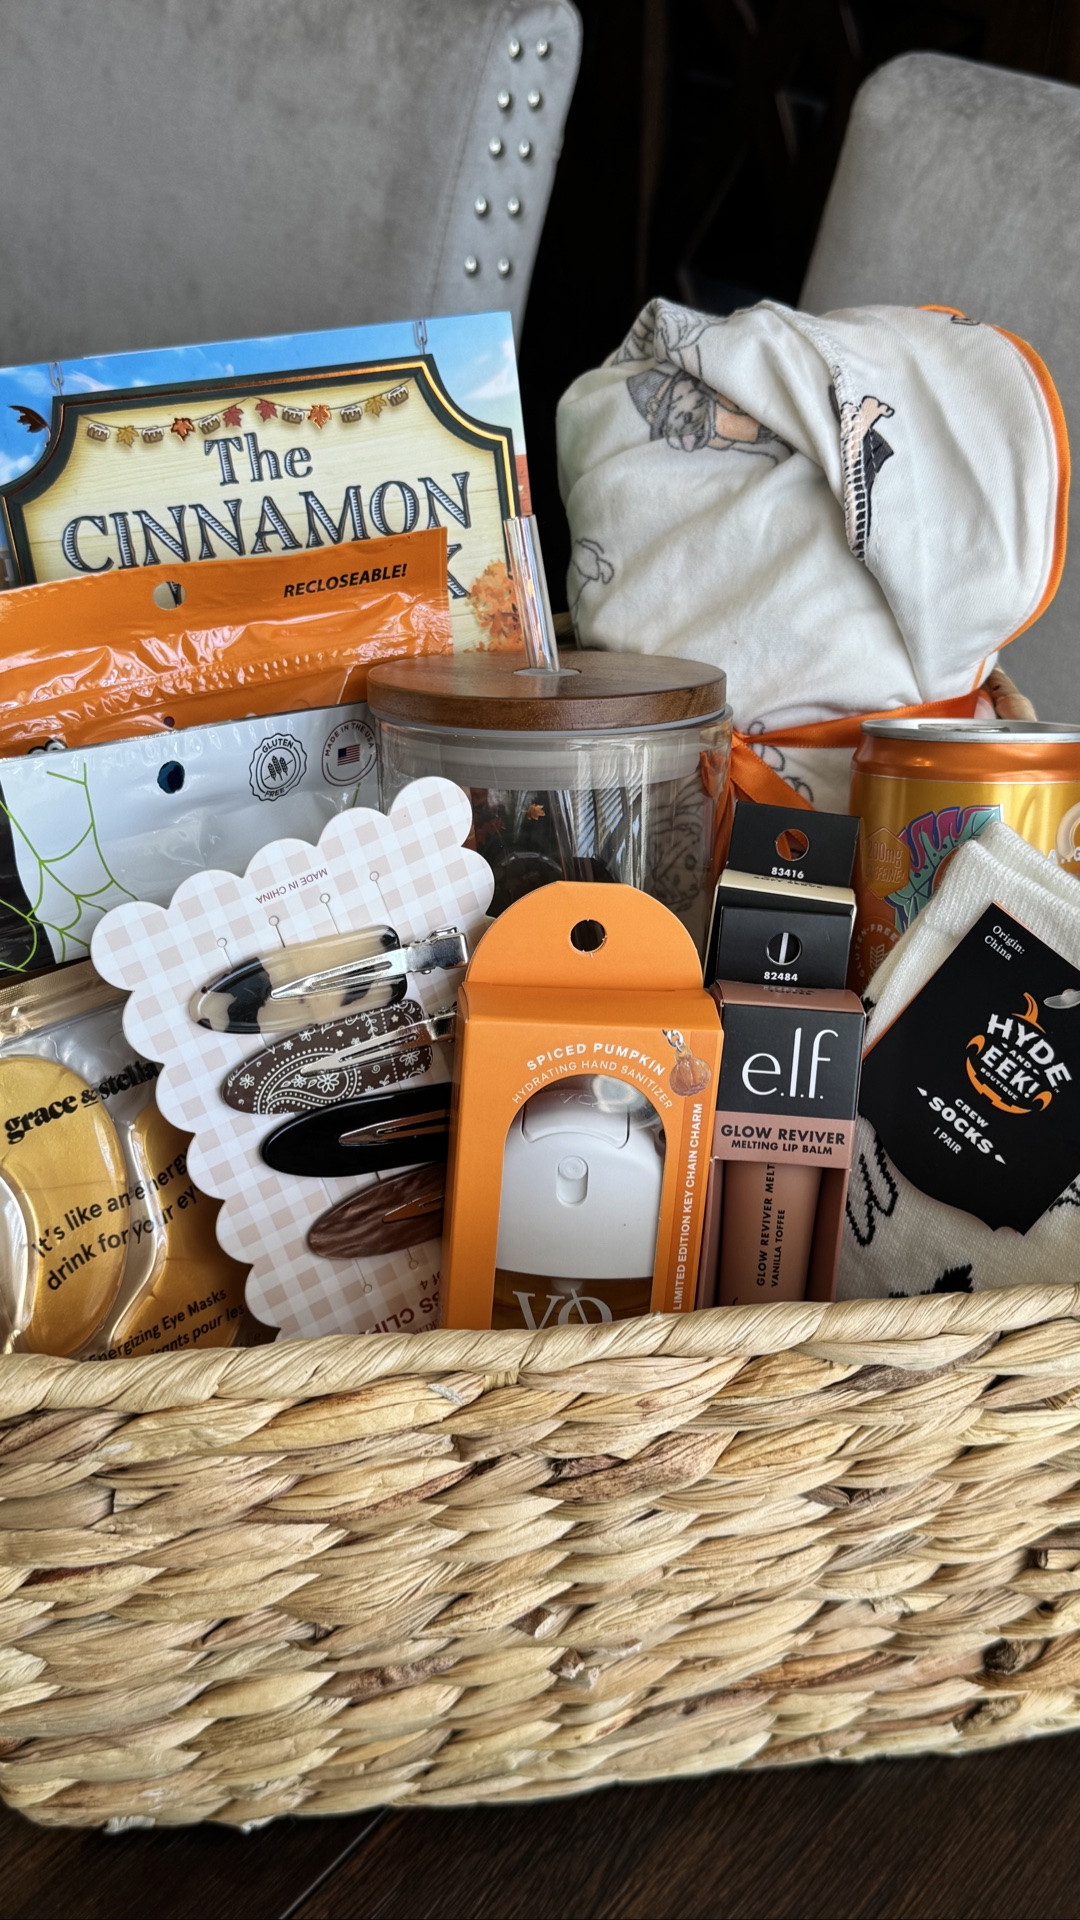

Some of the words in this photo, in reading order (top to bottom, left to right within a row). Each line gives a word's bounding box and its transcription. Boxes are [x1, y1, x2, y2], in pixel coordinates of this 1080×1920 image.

[204, 432, 313, 486] The
[62, 471, 471, 573] CINNAMON
[284, 563, 407, 598] RECLOSEABLE!
[262, 738, 295, 754] GLUTEN
[325, 731, 340, 757] MADE
[341, 723, 349, 733] IN
[351, 722, 365, 734] THE
[364, 728, 375, 749] USA
[264, 787, 285, 798] FREE
[288, 880, 299, 891] IN
[300, 868, 328, 886] MADE
[771, 866, 805, 879] 83416
[255, 886, 287, 904] CHINA
[984, 934, 1013, 961] China
[992, 925, 1026, 956] Origin:
[763, 971, 798, 982] 82484
[527, 1043, 587, 1071] SPICED
[593, 1043, 666, 1077] PUMPKIN
[986, 1013, 1073, 1088] HYDE
[1008, 1049, 1033, 1069] AND
[512, 1061, 577, 1104] HYDRATING
[581, 1060, 617, 1072] HAND
[621, 1066, 673, 1109] SANITIZER
[980, 1067, 1019, 1101] BOUTIQUE
[981, 1044, 1040, 1099] EEK!
[4, 1095, 78, 1145] grace
[81, 1089, 99, 1108] &
[99, 1059, 159, 1100] stella
[955, 1098, 989, 1128] CREW
[690, 1103, 703, 1148] CHARM
[721, 1124, 772, 1139] GLOW
[778, 1128, 845, 1145] REVIVER
[928, 1096, 994, 1154] SOCKS
[938, 1131, 962, 1154] PAIR
[731, 1140, 778, 1151] MELTING
[782, 1144, 798, 1153] LIP
[802, 1145, 833, 1155] BALM
[685, 1150, 698, 1188] CHAIN
[683, 1190, 694, 1213] KEY
[32, 1228, 66, 1259] It's
[64, 1200, 103, 1231] like
[107, 1192, 131, 1213] an
[761, 1197, 773, 1246] REVIVER
[776, 1209, 786, 1244] TOFFEE
[678, 1216, 690, 1263] EDITION
[46, 1242, 99, 1291] drink
[97, 1227, 130, 1253] for
[756, 1250, 768, 1286] GLOW
[771, 1247, 782, 1288] VANILLA
[420, 1280, 428, 1290] 4
[673, 1267, 686, 1310] LIMITED
[161, 1311, 186, 1332] Eye
[187, 1288, 227, 1317] Masks
[191, 1314, 223, 1343] pour
